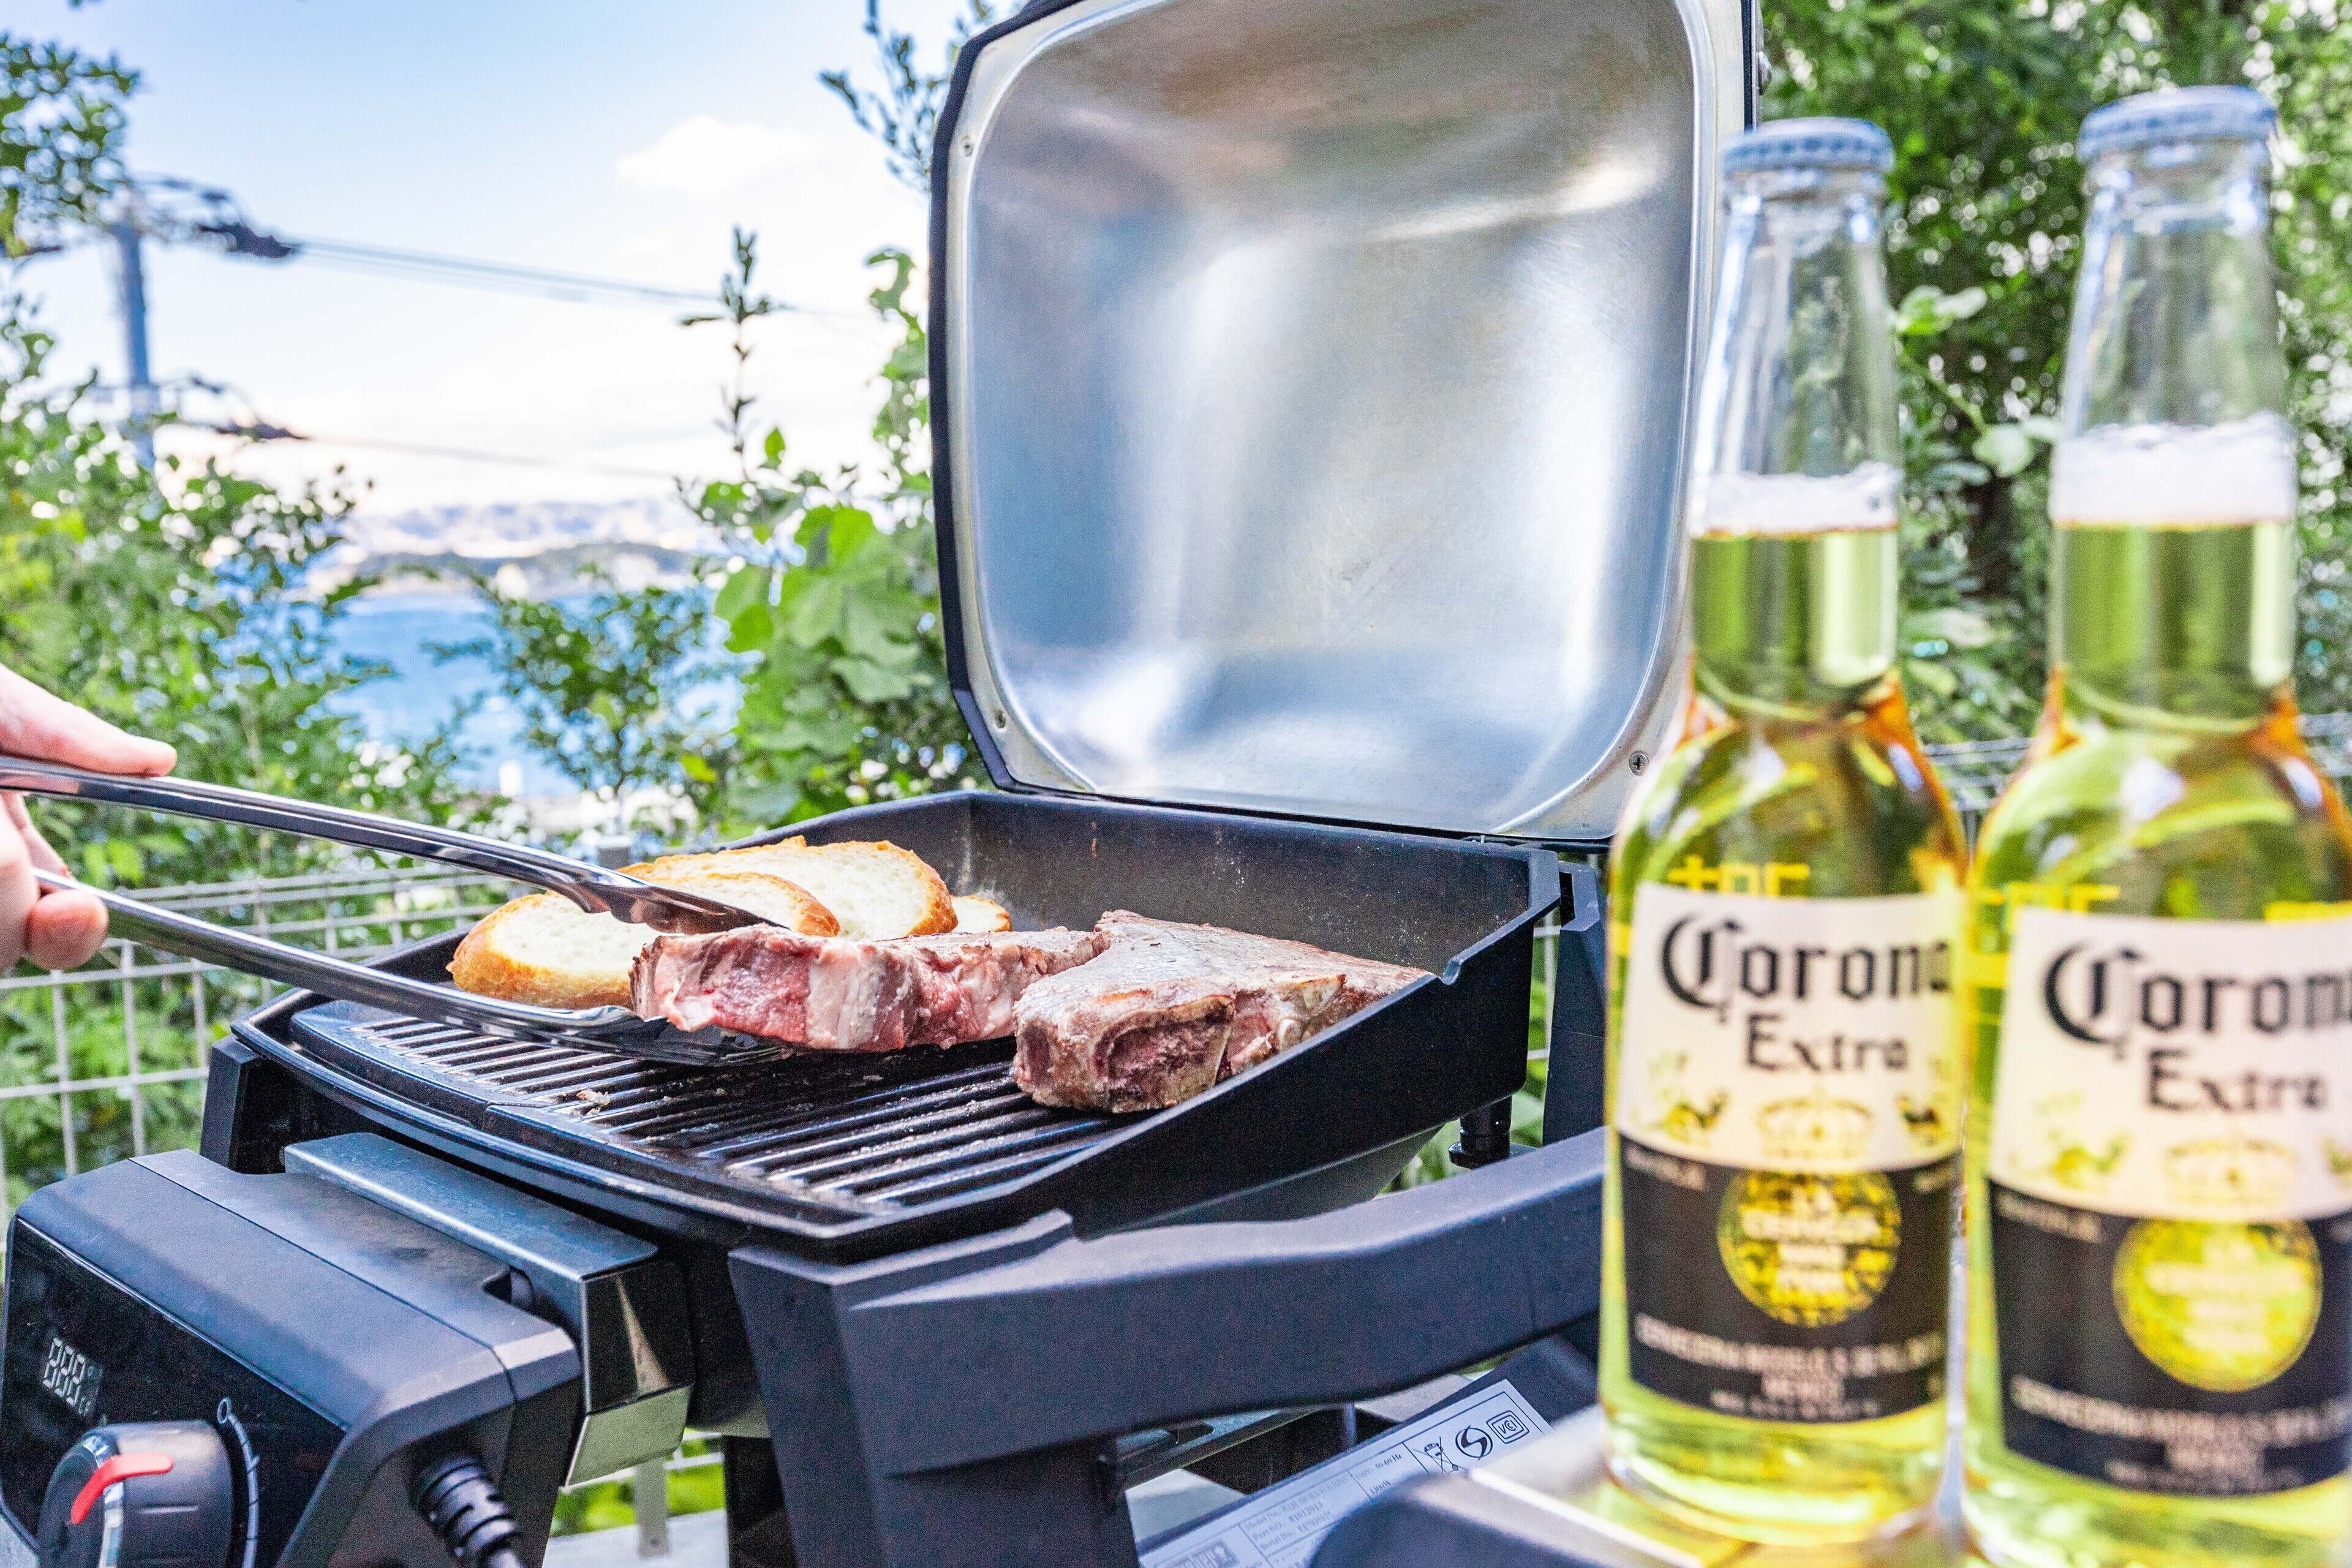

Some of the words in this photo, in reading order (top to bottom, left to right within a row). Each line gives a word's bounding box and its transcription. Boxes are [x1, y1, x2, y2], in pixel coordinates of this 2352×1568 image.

[2043, 941, 2352, 1061] Coron
[1746, 1013, 1909, 1072] Extra
[2147, 1046, 2328, 1112] Extra
